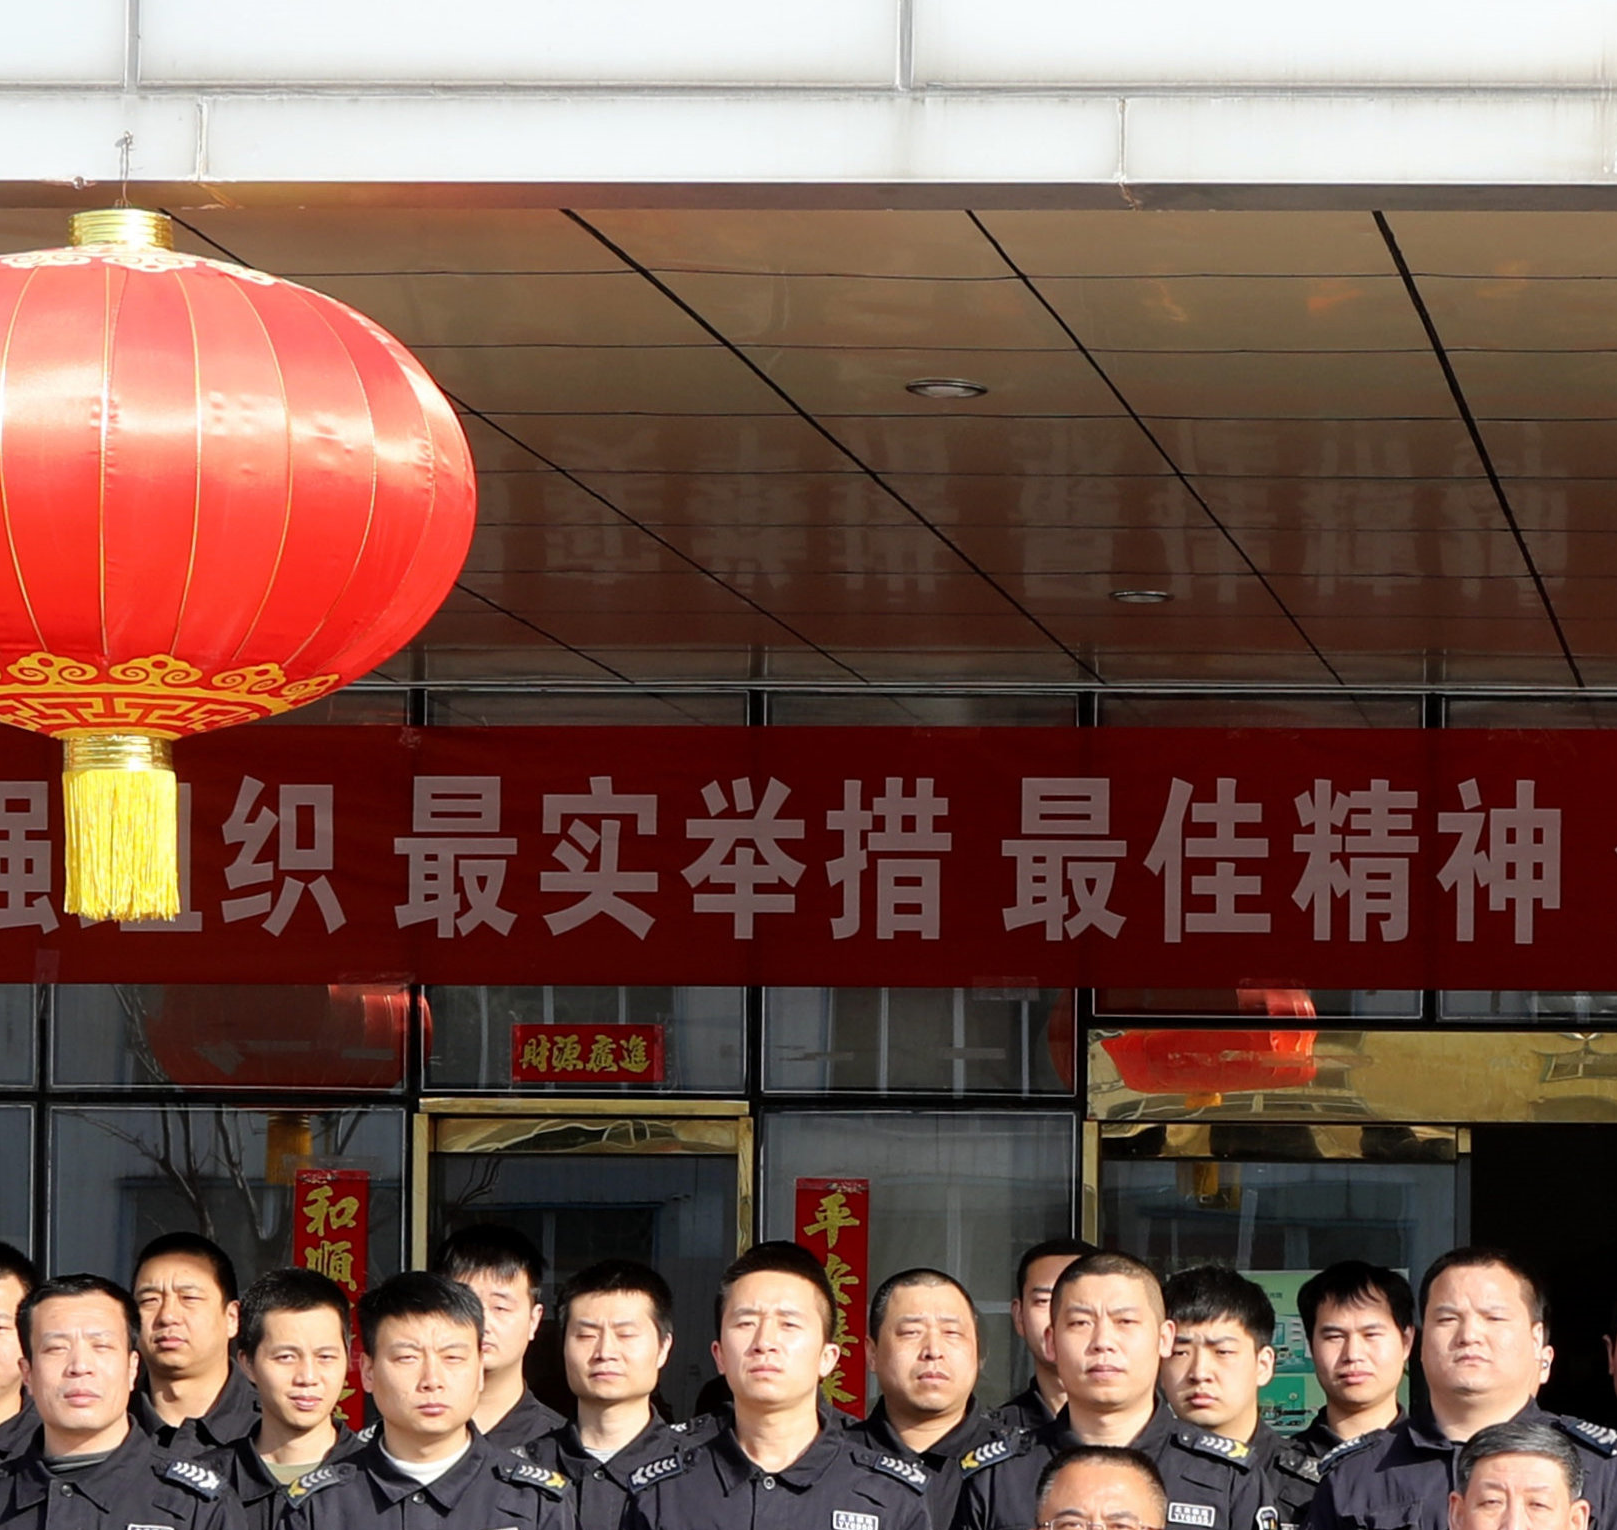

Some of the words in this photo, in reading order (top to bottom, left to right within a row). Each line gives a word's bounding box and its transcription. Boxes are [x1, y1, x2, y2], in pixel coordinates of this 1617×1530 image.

[393, 775, 953, 941] 最实举措
[1001, 777, 1563, 946] 最佳精神
